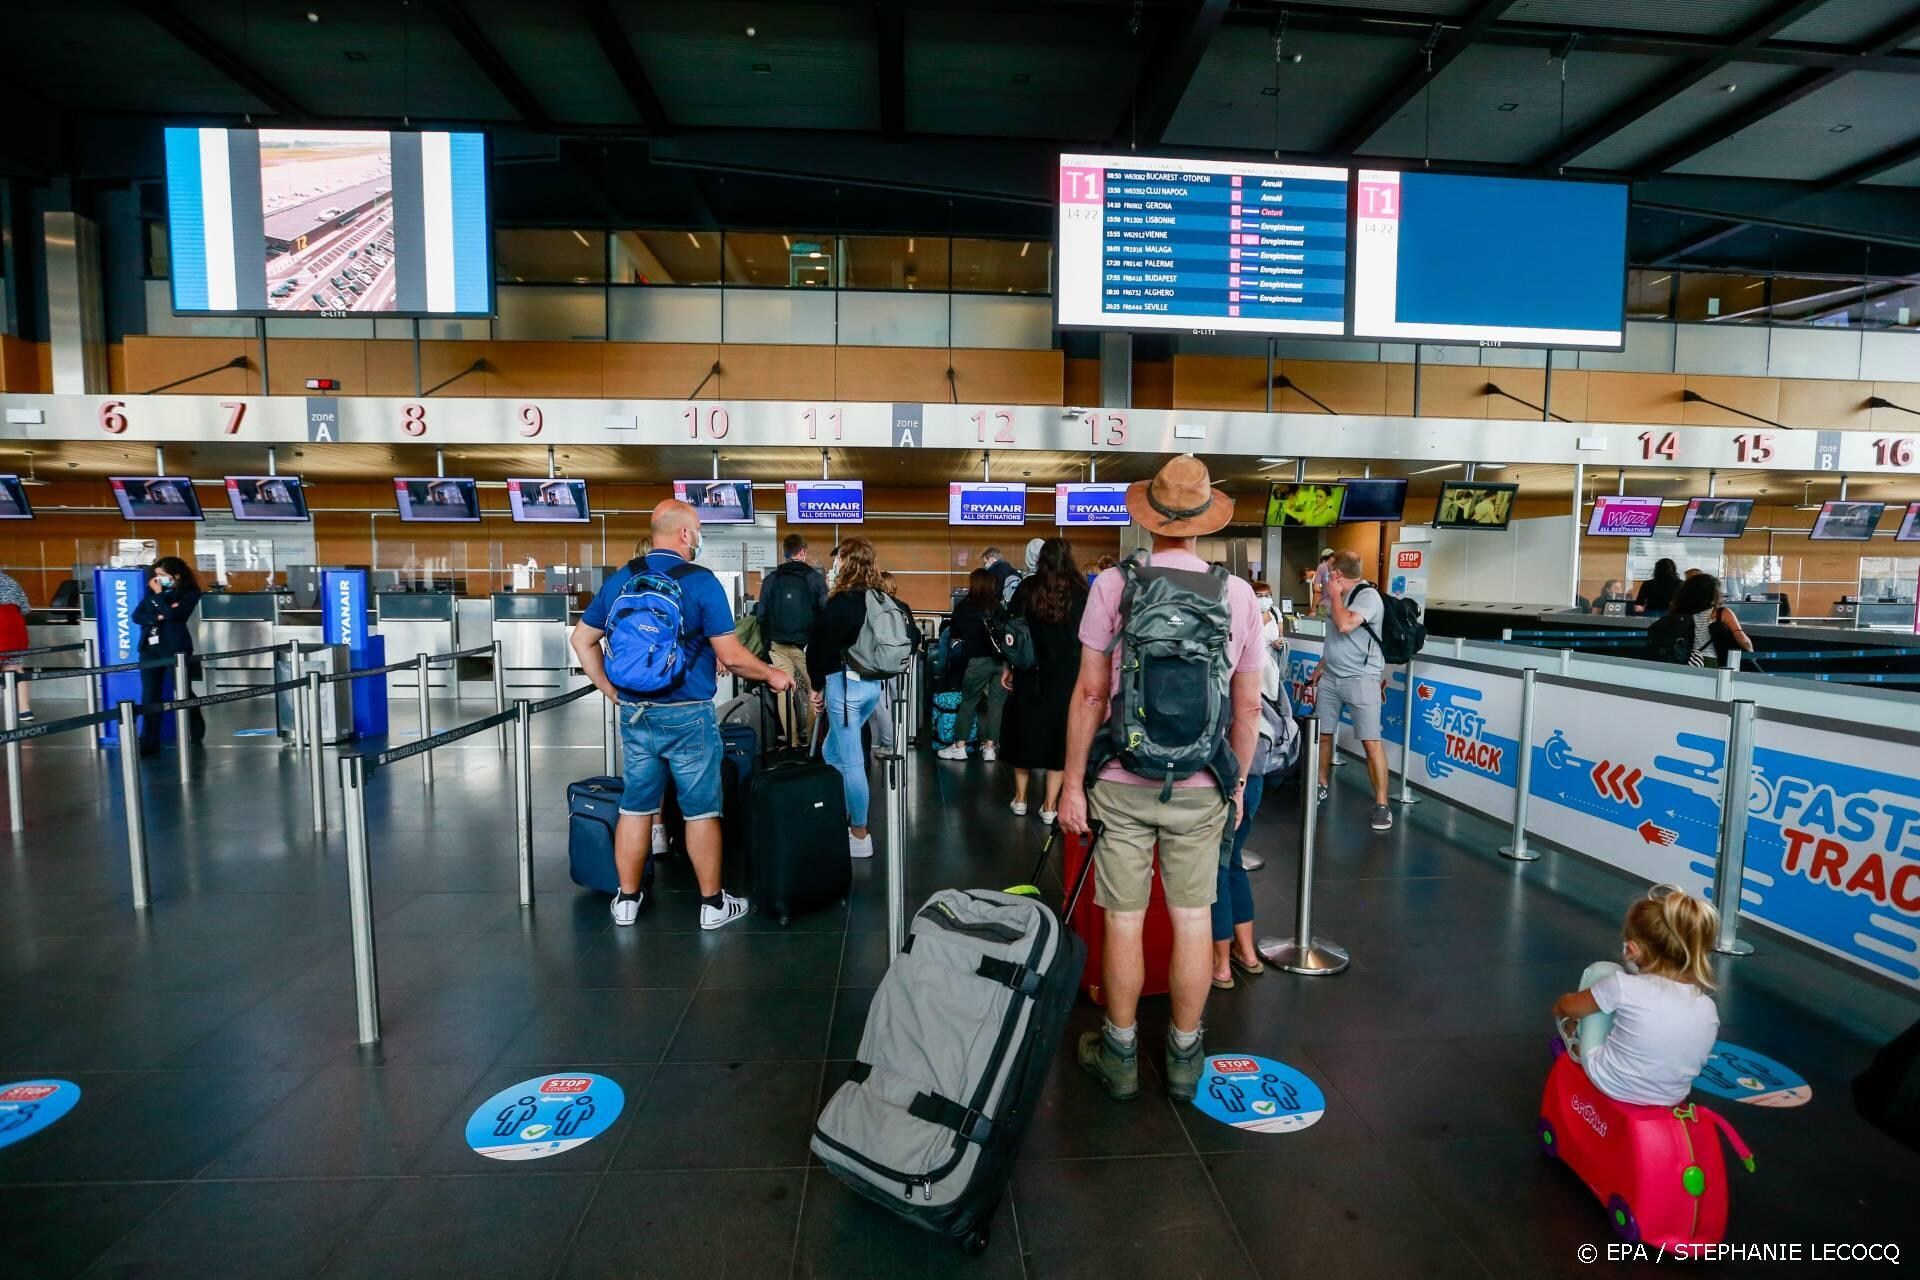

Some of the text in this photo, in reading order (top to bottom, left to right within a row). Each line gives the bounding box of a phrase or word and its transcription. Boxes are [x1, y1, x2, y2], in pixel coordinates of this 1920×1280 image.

[1065, 171, 1100, 200] T1
[1146, 172, 1178, 182] BUCAREST
[1183, 174, 1211, 183] OTOPENI
[1145, 187, 1161, 195] CLUJ
[1161, 188, 1188, 196] NAPOCA
[1145, 202, 1173, 210] GERONA
[1363, 186, 1395, 215] T1
[1145, 216, 1176, 225] LISBONNE
[1260, 222, 1305, 233] Enregistrement
[1145, 231, 1168, 239] VIENNE
[1260, 237, 1305, 247] Enregistrement
[1145, 246, 1173, 254] MALAGA
[1260, 251, 1304, 261] Enregistrement
[1145, 260, 1175, 268] PALERME
[1260, 265, 1304, 275] Enregistrement
[1145, 274, 1177, 283] BUDAPEST
[1259, 280, 1303, 290] Enregistrement
[1144, 289, 1175, 297] ALGHERO
[1259, 294, 1303, 304] Enregistrement
[1144, 303, 1168, 311] SEVILLE
[1192, 328, 1216, 336] Q-LITE
[99, 400, 129, 434] 6
[220, 402, 247, 435] 7
[311, 413, 335, 422] zone
[400, 403, 427, 437] 8
[519, 403, 543, 437] 9
[683, 406, 729, 439] 10
[802, 408, 842, 441] 11
[896, 419, 919, 428] zone
[316, 422, 332, 442] A
[971, 410, 1016, 444] 12
[1084, 412, 1130, 445] 13
[900, 429, 915, 447] A
[1638, 431, 1681, 461] 14
[1733, 434, 1775, 463] 15
[1818, 445, 1838, 453] zone
[1872, 438, 1915, 467] 16
[1822, 454, 1833, 470] B
[808, 502, 860, 510] RYANAIR
[971, 504, 1022, 513] RYANAIR
[1076, 505, 1128, 513] RYANAIR
[1400, 553, 1419, 562] STOP
[115, 579, 130, 649] RYANAIR
[340, 580, 352, 646] RYANAIR
[1291, 661, 1317, 681] FAS
[9, 725, 48, 740] AIRPORT
[1443, 708, 1486, 740] FAST
[386, 744, 416, 761] BRUSSELS
[414, 738, 435, 752] SOUTH
[435, 728, 465, 745] CHARLEROI
[1446, 734, 1502, 773] TRACK
[1773, 780, 1920, 852] FAST
[1218, 1060, 1251, 1068] STOP
[550, 1079, 587, 1087] STOP
